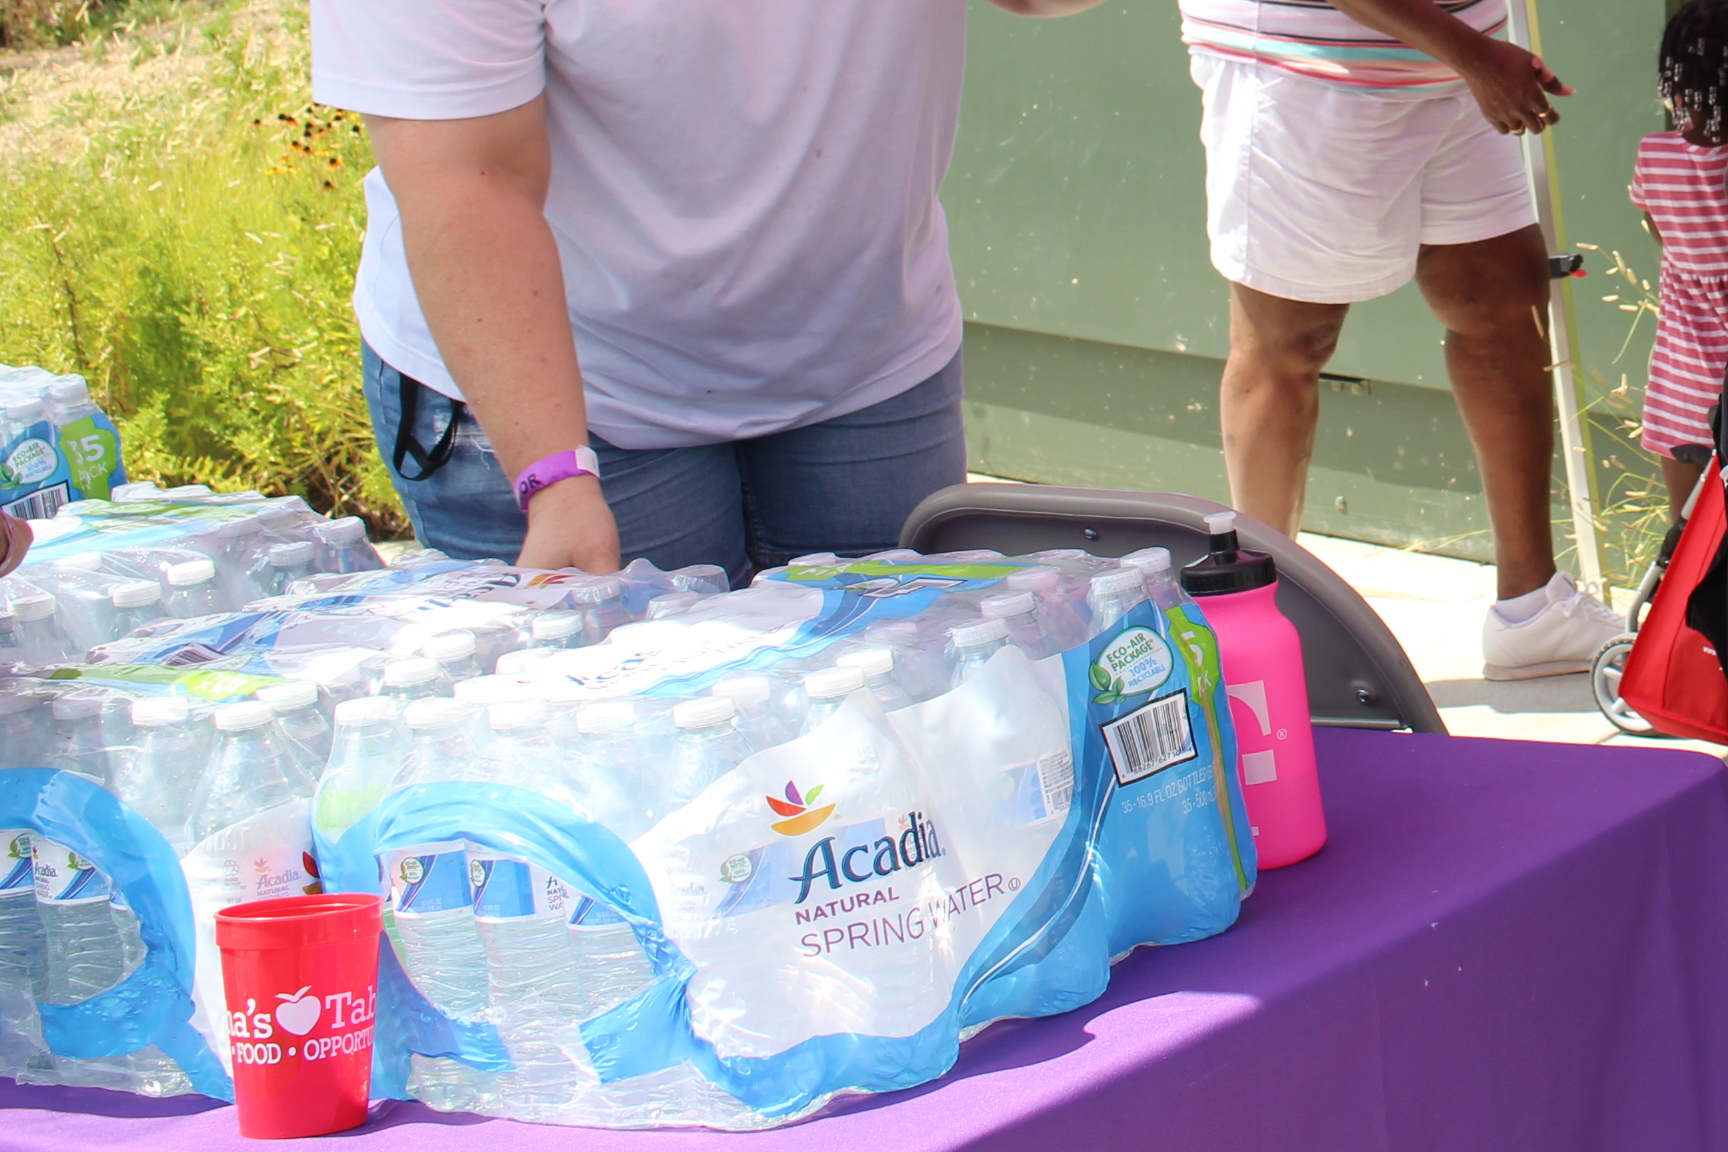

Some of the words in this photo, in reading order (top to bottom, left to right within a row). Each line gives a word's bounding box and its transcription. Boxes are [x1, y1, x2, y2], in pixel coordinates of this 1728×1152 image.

[1106, 631, 1147, 664] ECO-AIR
[1111, 641, 1153, 673] PACKAGE
[1128, 657, 1158, 677] 100%
[1128, 664, 1166, 688] RECYCLABLE
[788, 811, 942, 904] Acadia
[256, 869, 301, 890] Acadia
[795, 886, 900, 925] NATURAL
[801, 907, 925, 957] SPRING
[929, 873, 1005, 929] WATER
[236, 1042, 281, 1064] FOOD
